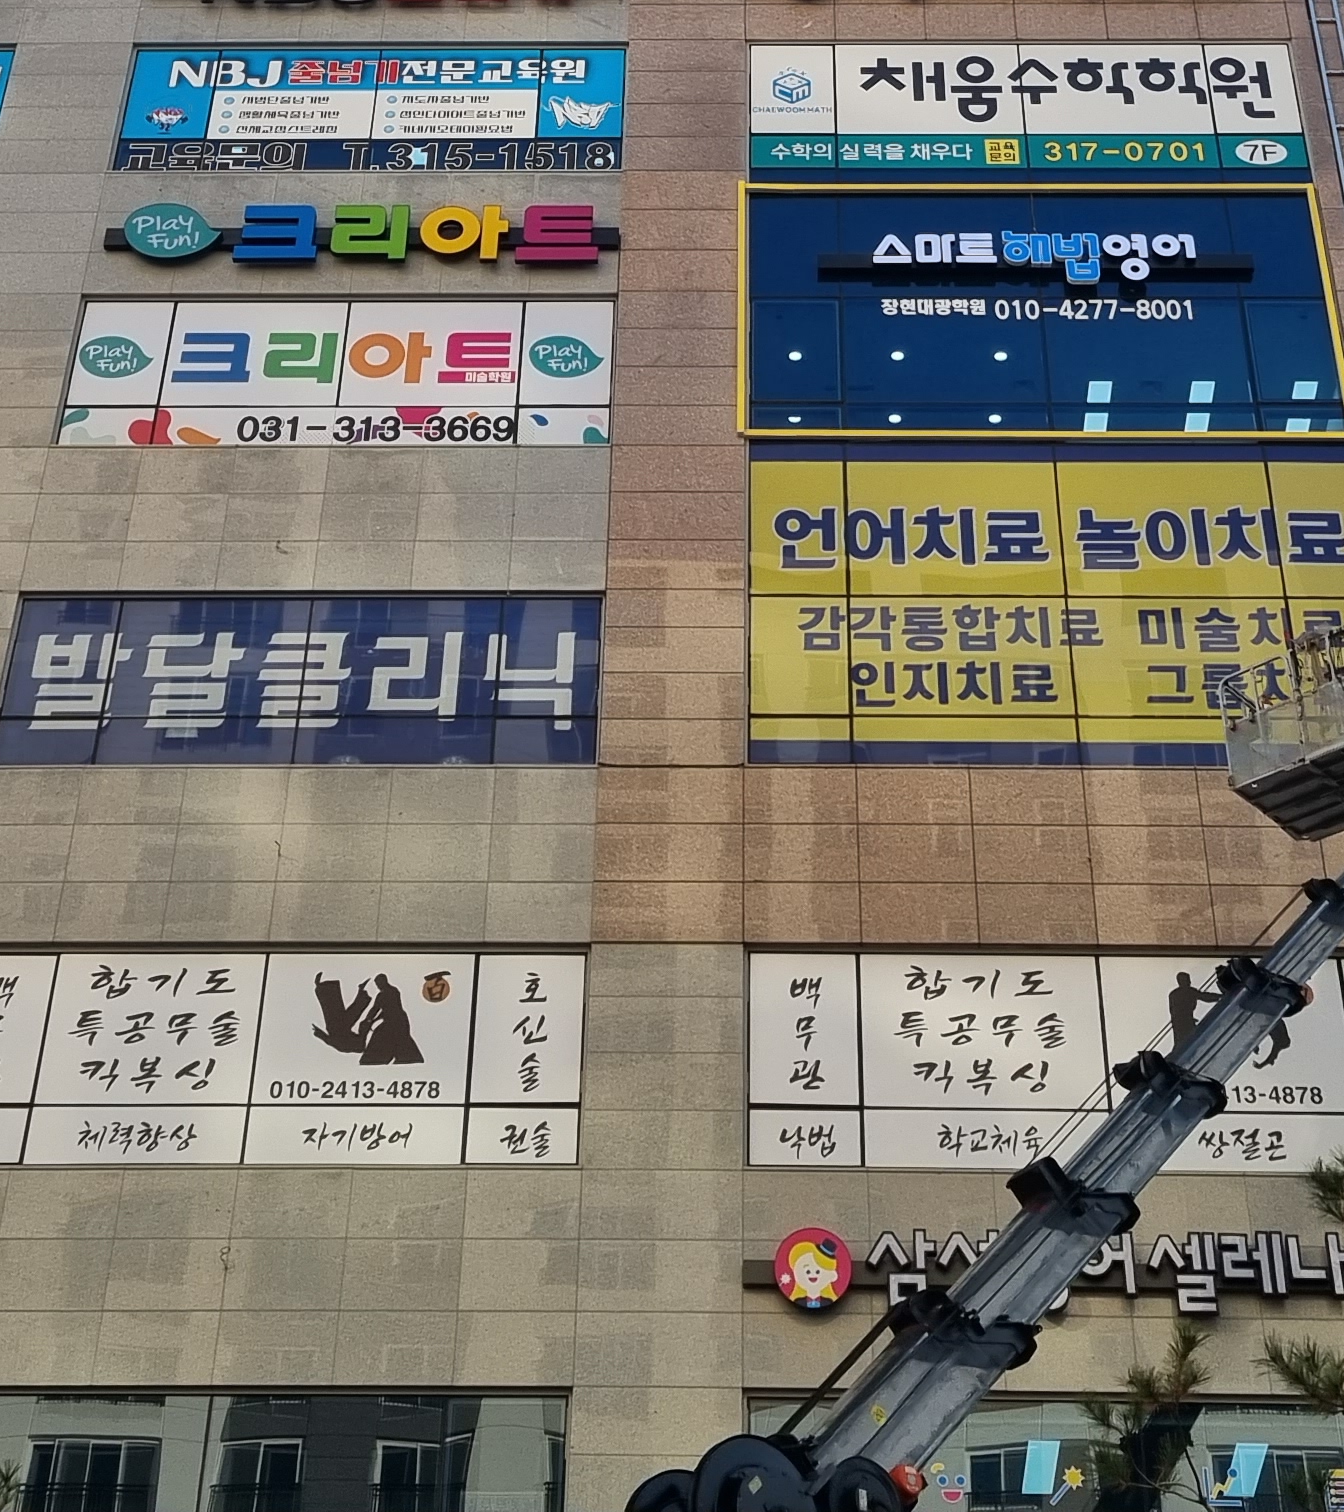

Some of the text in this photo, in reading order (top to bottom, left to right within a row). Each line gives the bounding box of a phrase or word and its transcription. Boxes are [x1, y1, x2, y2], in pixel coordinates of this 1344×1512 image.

[860, 56, 1276, 124] 채움수학학원
[752, 106, 833, 114] CHAEWOOM MATH
[120, 141, 616, 172] 교육문의 T.315-1518
[770, 142, 974, 162] 수학의 실력을 채우다
[987, 140, 1017, 153] 교육
[987, 152, 1017, 164] 문의
[1043, 141, 1279, 164] 317-0701 7F
[129, 211, 196, 235] Play
[232, 204, 600, 264] 크리아트
[146, 230, 202, 251] Fun!
[879, 297, 1196, 322] 장현대광학원 010-4277-8001
[84, 342, 134, 362] Play
[95, 356, 139, 372] Fun!
[170, 331, 517, 385] 크리아트
[534, 342, 585, 361] Play
[546, 356, 589, 372] Fun!
[463, 370, 513, 383] 미술학원
[236, 415, 517, 443] 031-313-3669
[772, 505, 1051, 571] 언어치료
[796, 603, 1105, 653] 감각통합치료
[27, 630, 578, 740] 발달클리닉
[850, 658, 1059, 707] 인지치료
[90, 964, 238, 1000] 합기도
[903, 963, 1056, 1000] 합기도
[66, 1010, 241, 1048] 특공무술
[892, 1009, 1069, 1050] 특공무술
[78, 1056, 219, 1095] 킥복싱
[268, 1079, 442, 1102] 010-2413-4878
[912, 1057, 1051, 1096] 킥복싱
[77, 1121, 199, 1152] 체력향상
[300, 1122, 415, 1150] 자기방어
[778, 1125, 837, 1160] 낙법
[936, 1123, 1045, 1159] 학교체육
[1197, 1126, 1289, 1163] 쌍절곤
